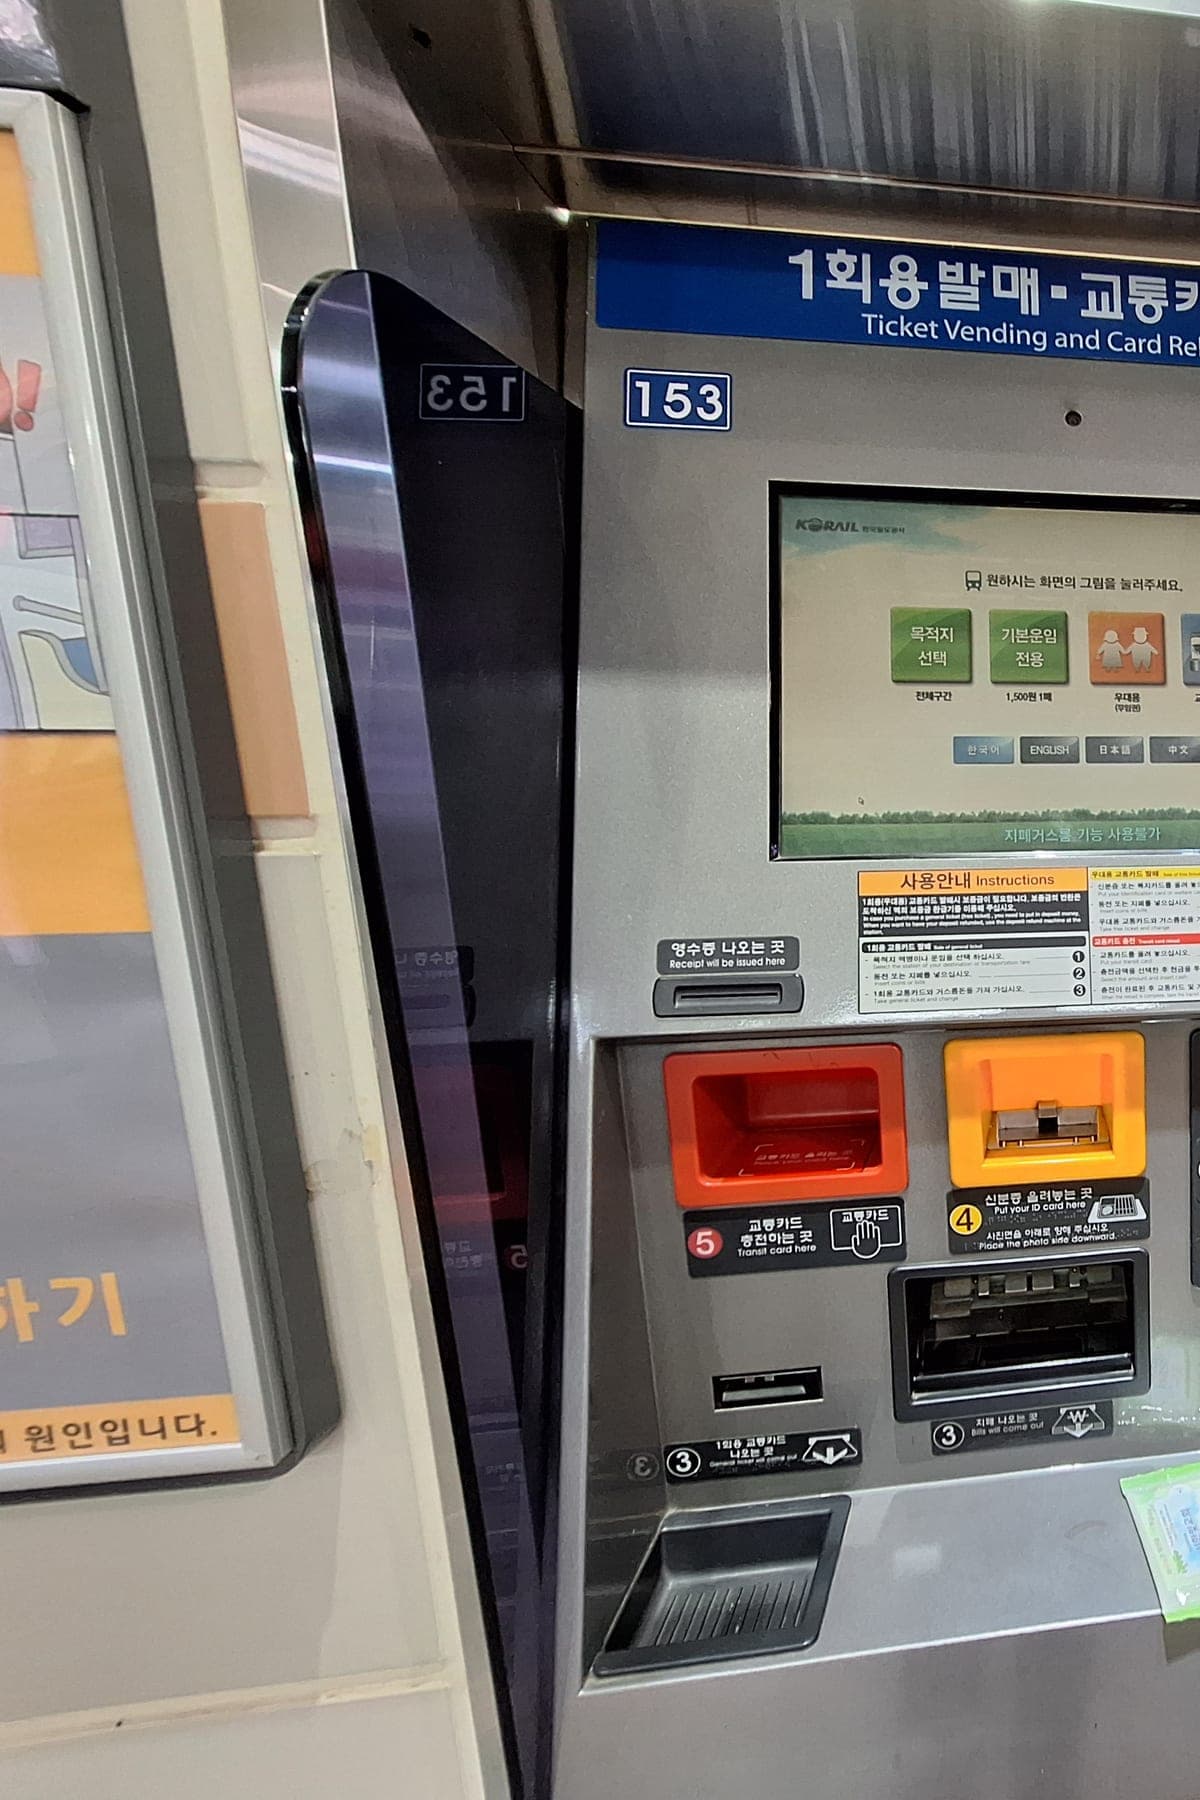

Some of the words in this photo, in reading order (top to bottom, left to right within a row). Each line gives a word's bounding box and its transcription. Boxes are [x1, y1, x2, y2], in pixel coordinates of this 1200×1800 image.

[862, 313, 938, 341] Ticket
[944, 320, 1048, 351] Vending
[1055, 327, 1101, 350] and
[1107, 332, 1163, 355] Card
[635, 381, 723, 421] 153
[796, 518, 859, 532] KORAIL
[986, 574, 1036, 587] 원하시는
[1039, 576, 1076, 588] 화면의
[1080, 577, 1116, 590] 그림을
[1120, 578, 1183, 592] 눌러주세요.
[910, 626, 954, 643] 목적지
[1001, 628, 1057, 645] 기본운임
[918, 651, 947, 667] 선택
[1015, 651, 1044, 668] 전용
[1030, 744, 1070, 755] ENGLISH
[1100, 744, 1131, 755] 日本語
[1168, 744, 1189, 755] 中文
[1078, 828, 1103, 842] 기능
[1108, 827, 1161, 841] 사용불가
[900, 872, 971, 890] 사용안내
[976, 874, 1055, 887] Instructions
[671, 941, 716, 958] 영수증
[722, 940, 765, 955] 나오는
[770, 939, 785, 954] 곳
[669, 958, 705, 969] Receipt
[706, 958, 720, 968] will
[721, 958, 734, 967] be
[736, 957, 764, 967] issued
[765, 957, 786, 966] here
[984, 1192, 1022, 1208] 신분증
[1026, 1188, 1077, 1203] 올려놓는
[1081, 1187, 1094, 1200] 곳
[994, 1206, 1009, 1215] Put
[1009, 1205, 1030, 1216] your
[1031, 1204, 1041, 1212] ID
[1043, 1202, 1064, 1211] card
[1066, 1200, 1086, 1210] here
[748, 1216, 803, 1233] 교통카드
[1025, 1227, 1051, 1238] 아래로
[1074, 1222, 1109, 1234] 주십시오
[740, 1231, 795, 1248] 충전하는
[799, 1229, 814, 1244] 곳
[979, 1241, 1004, 1251] Place
[1006, 1240, 1021, 1249] the
[1023, 1238, 1050, 1249] photo
[1051, 1235, 1069, 1245] side
[1071, 1232, 1117, 1244] downward.
[737, 1246, 768, 1258] Transit
[769, 1245, 793, 1256] card
[794, 1243, 817, 1254] here
[975, 1416, 995, 1428] 지폐
[997, 1414, 1026, 1426] 나오는
[1028, 1412, 1038, 1423] 곳
[24, 1412, 218, 1453] 원인입니다.
[971, 1427, 986, 1437] Bills
[987, 1426, 1001, 1436] will
[1002, 1424, 1029, 1434] come
[1030, 1421, 1044, 1431] out
[746, 1434, 787, 1447] 교통카드
[730, 1448, 760, 1459] 나오는
